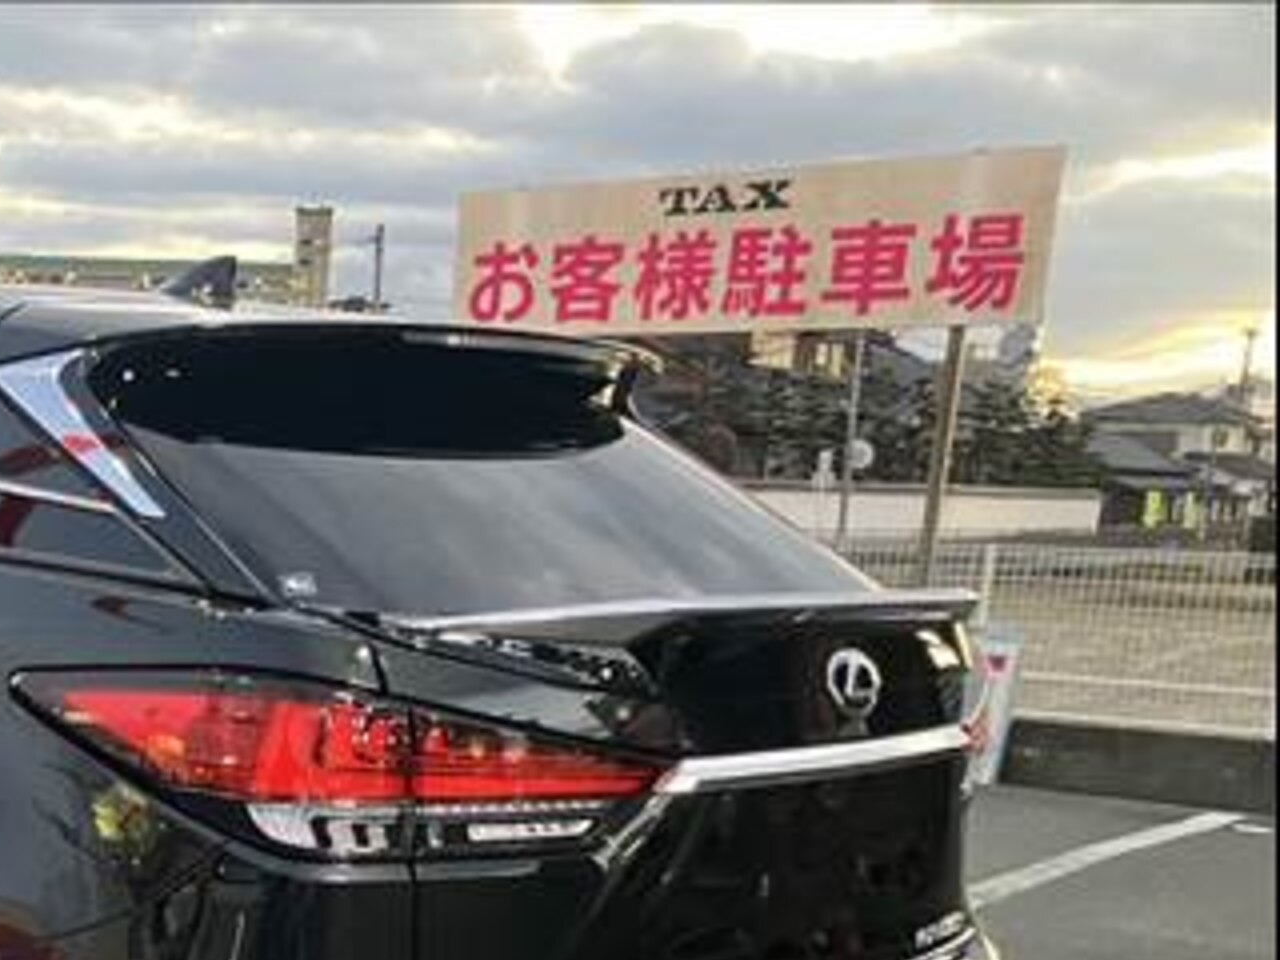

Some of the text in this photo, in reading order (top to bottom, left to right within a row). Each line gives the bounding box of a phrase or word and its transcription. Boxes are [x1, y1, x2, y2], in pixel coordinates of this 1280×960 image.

[659, 180, 790, 216] TAX
[468, 213, 1026, 323] お客様駐車場
